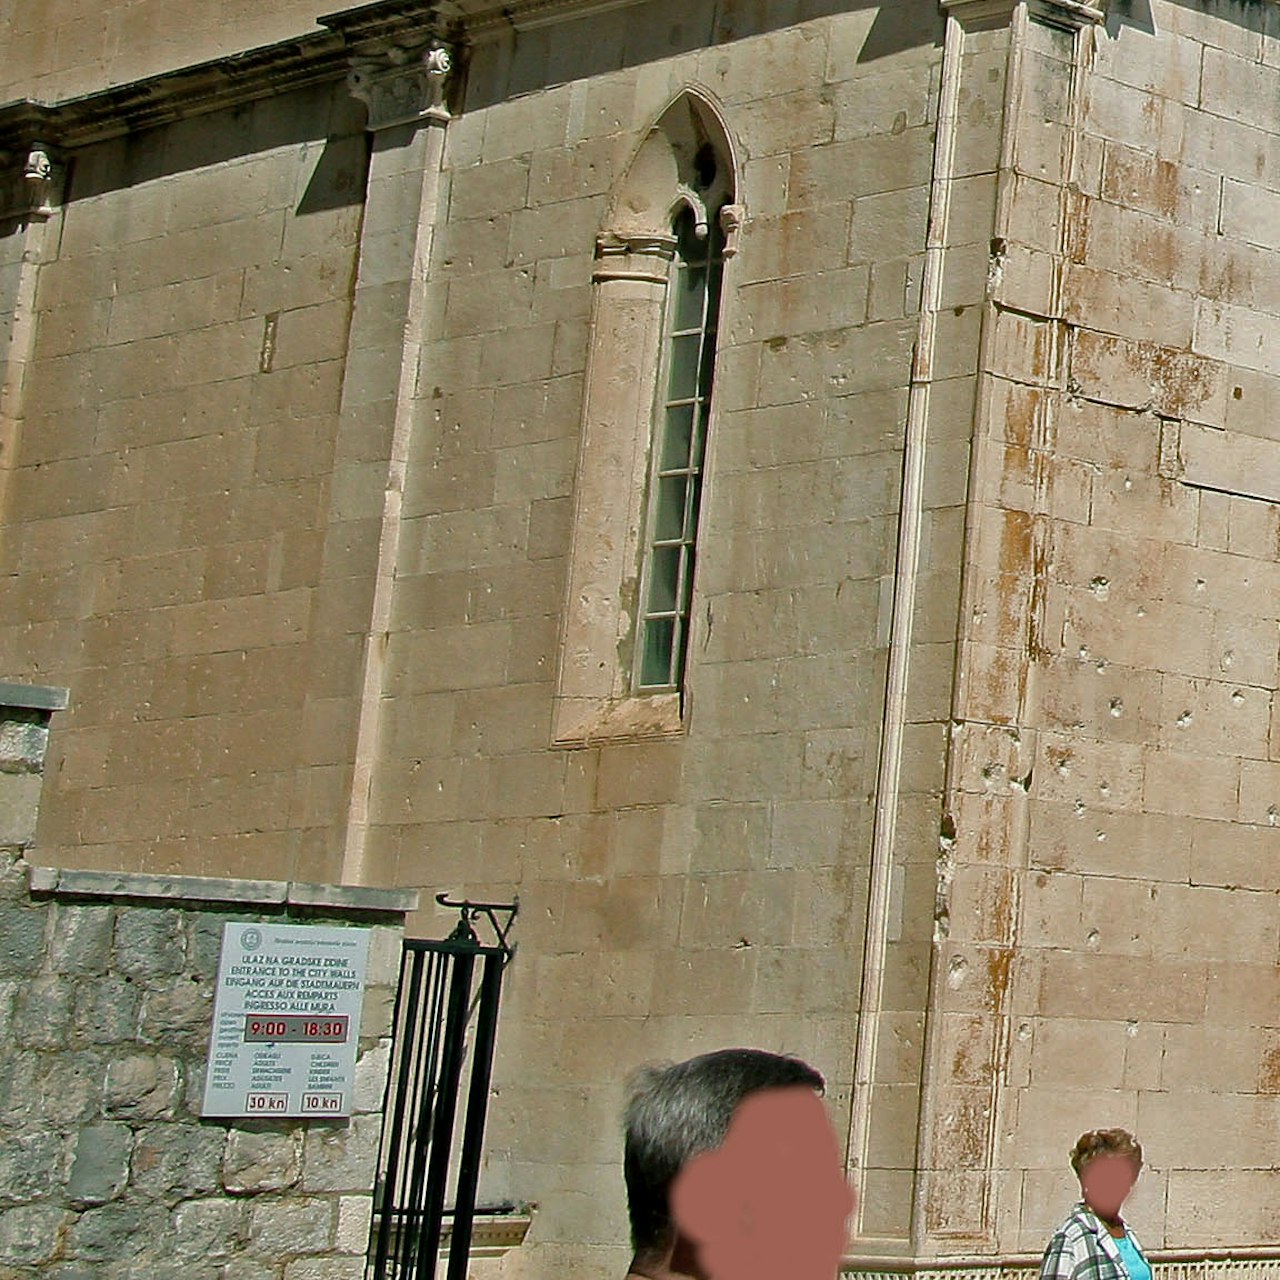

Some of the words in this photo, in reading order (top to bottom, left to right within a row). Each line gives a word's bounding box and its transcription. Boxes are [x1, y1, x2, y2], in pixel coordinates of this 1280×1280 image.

[242, 955, 263, 964] ULAZ
[266, 956, 280, 965] NA
[281, 957, 321, 967] GRADSKE
[230, 966, 276, 976] ENTRANCE
[278, 967, 290, 976] TO
[292, 968, 307, 977] THE
[308, 969, 328, 978] CITY
[330, 970, 356, 979] WALLS
[226, 977, 265, 987] EINGANG
[268, 978, 285, 987] AUF
[286, 979, 299, 988] DIE
[244, 990, 275, 999] ACCES
[277, 990, 295, 999] AUX
[297, 991, 338, 1000] REMPARTS
[244, 1000, 288, 1010] INGRESSO
[289, 1002, 308, 1011] ALLE
[310, 1002, 335, 1012] MURA
[251, 1022, 286, 1035] 9:00
[303, 1022, 342, 1035] 18:30
[250, 1097, 265, 1109] 30
[268, 1097, 284, 1110] kn
[306, 1097, 318, 1109] 10
[322, 1097, 338, 1110] kn
